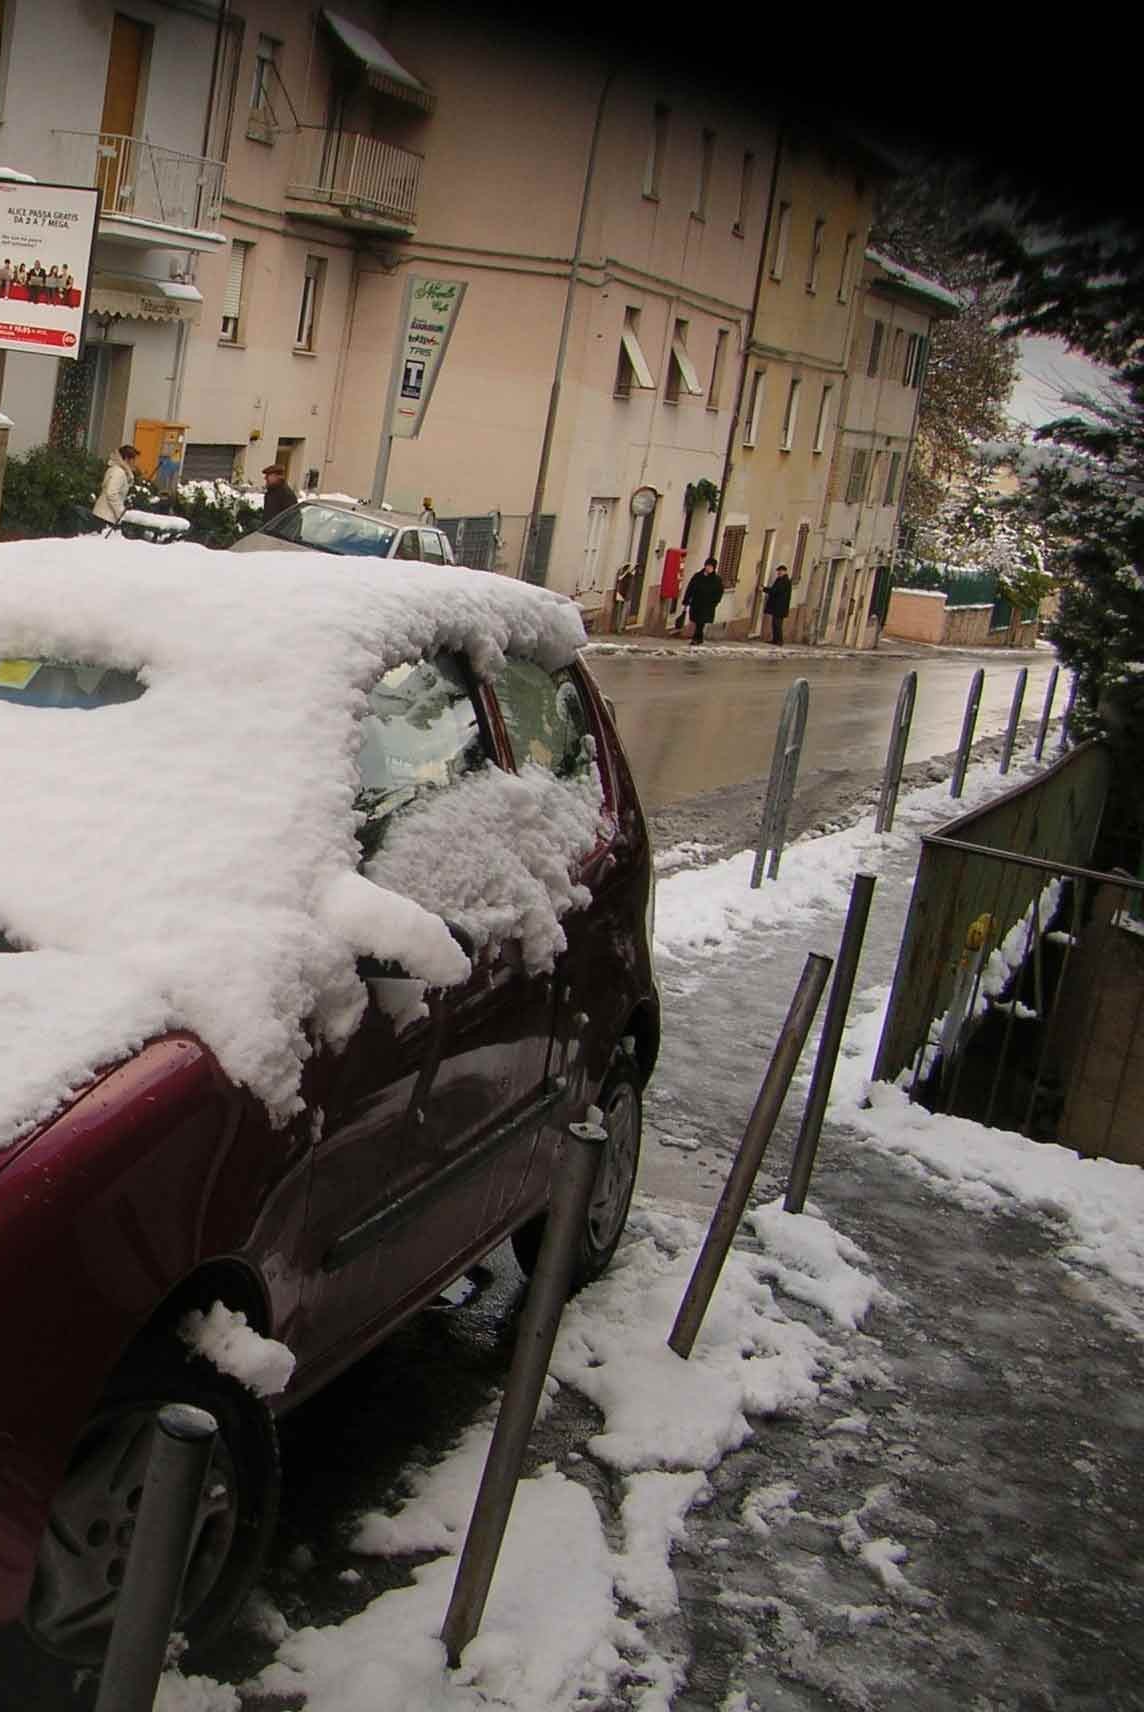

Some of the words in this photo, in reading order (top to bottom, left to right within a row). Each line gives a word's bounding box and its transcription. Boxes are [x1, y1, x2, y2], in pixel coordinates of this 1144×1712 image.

[8, 207, 27, 217] ALICE
[28, 209, 52, 220] PASSA
[53, 211, 80, 222] GRATIS
[14, 215, 24, 224] DA
[25, 217, 31, 225] 2
